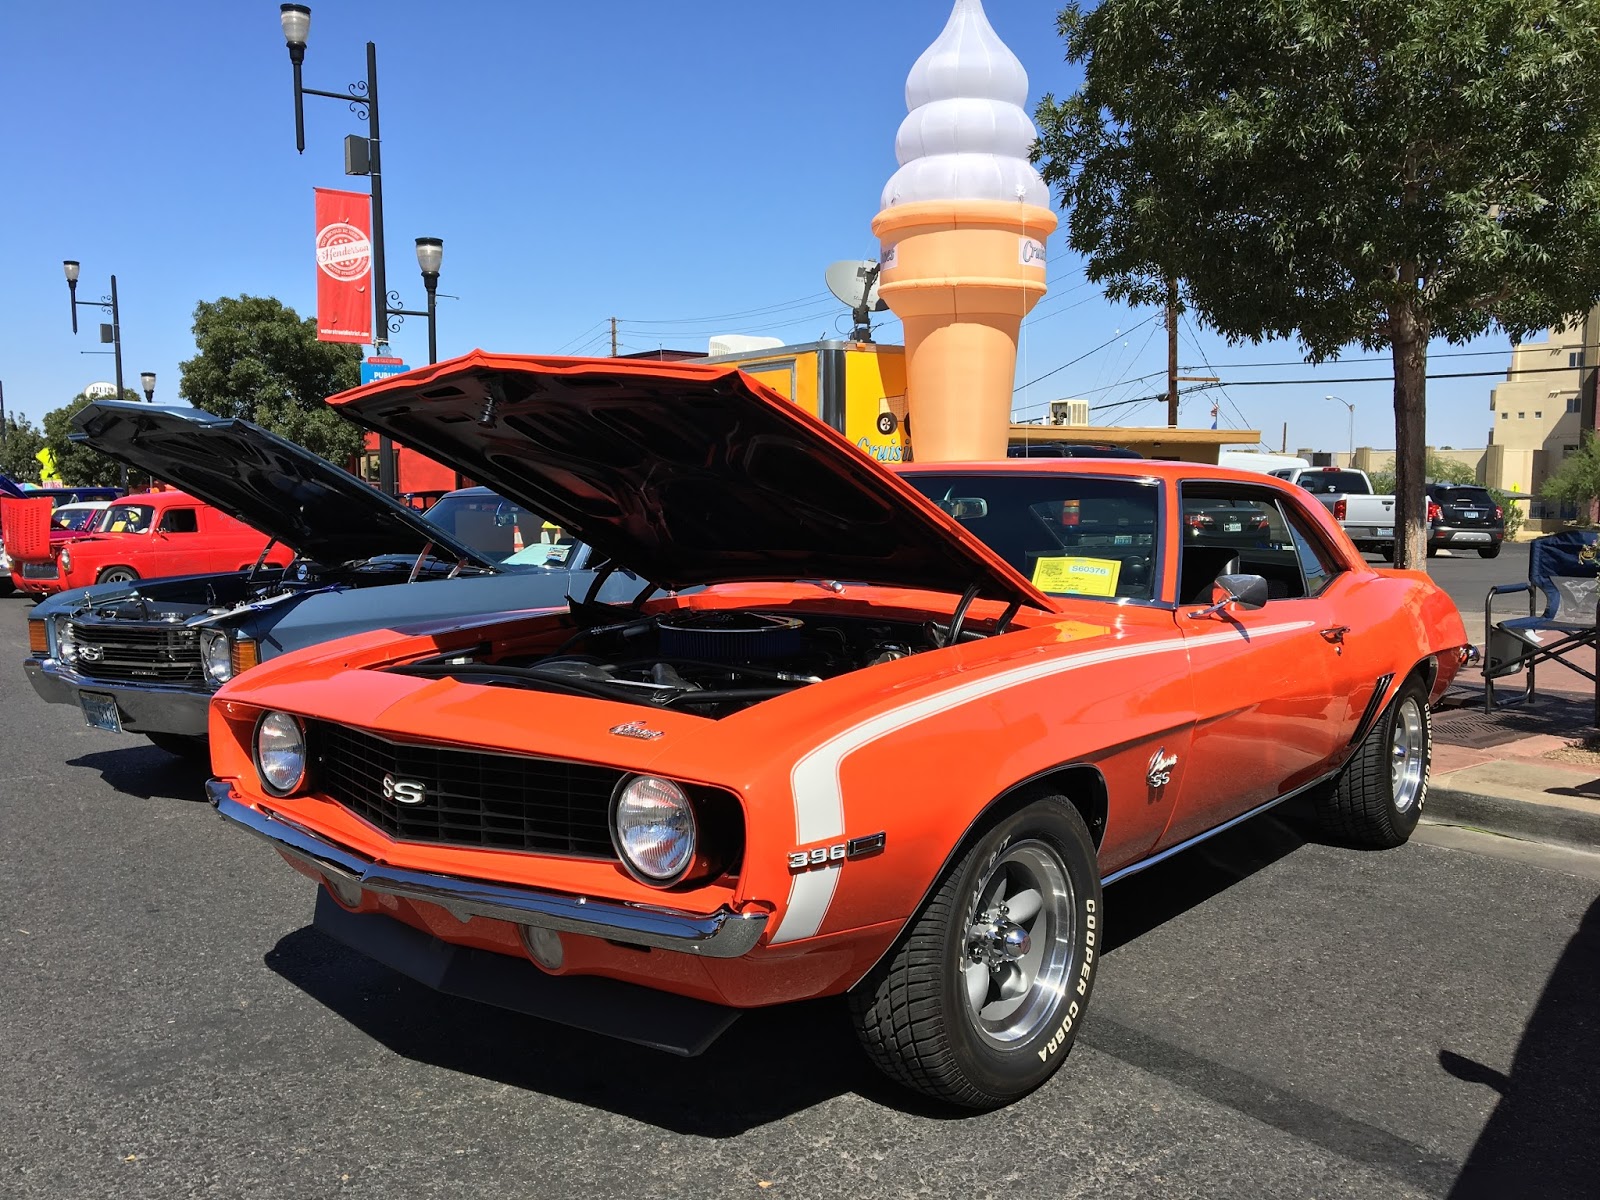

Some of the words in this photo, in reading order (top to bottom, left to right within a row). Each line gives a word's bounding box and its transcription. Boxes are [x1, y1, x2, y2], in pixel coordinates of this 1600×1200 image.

[317, 245, 369, 263] Henderson
[1072, 565, 1106, 575] S60376
[383, 774, 427, 804] SS
[787, 843, 846, 868] 396
[1077, 899, 1096, 996] COOPER
[1038, 1000, 1079, 1062] COBRA
